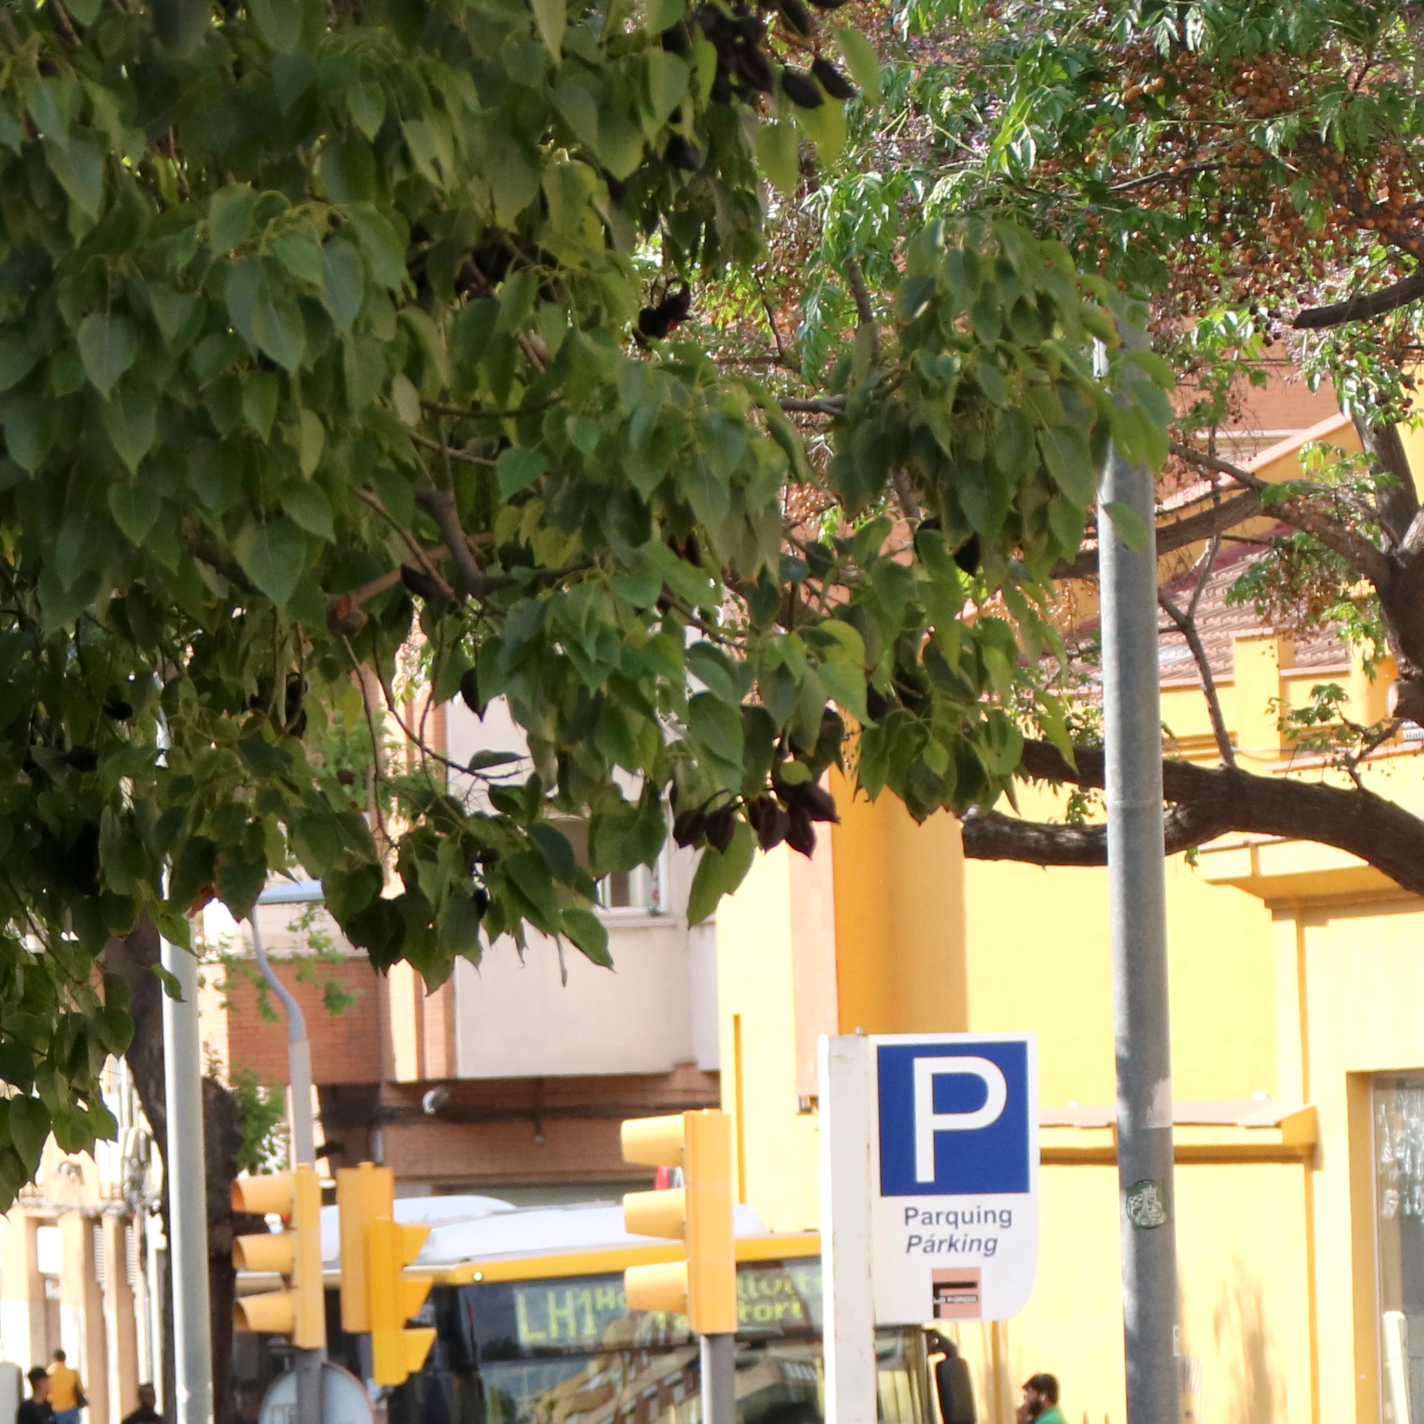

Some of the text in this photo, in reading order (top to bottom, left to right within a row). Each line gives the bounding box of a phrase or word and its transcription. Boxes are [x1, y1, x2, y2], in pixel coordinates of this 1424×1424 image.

[912, 1055, 1008, 1184] P
[904, 1206, 1013, 1229] Parquing
[905, 1234, 999, 1257] Párking
